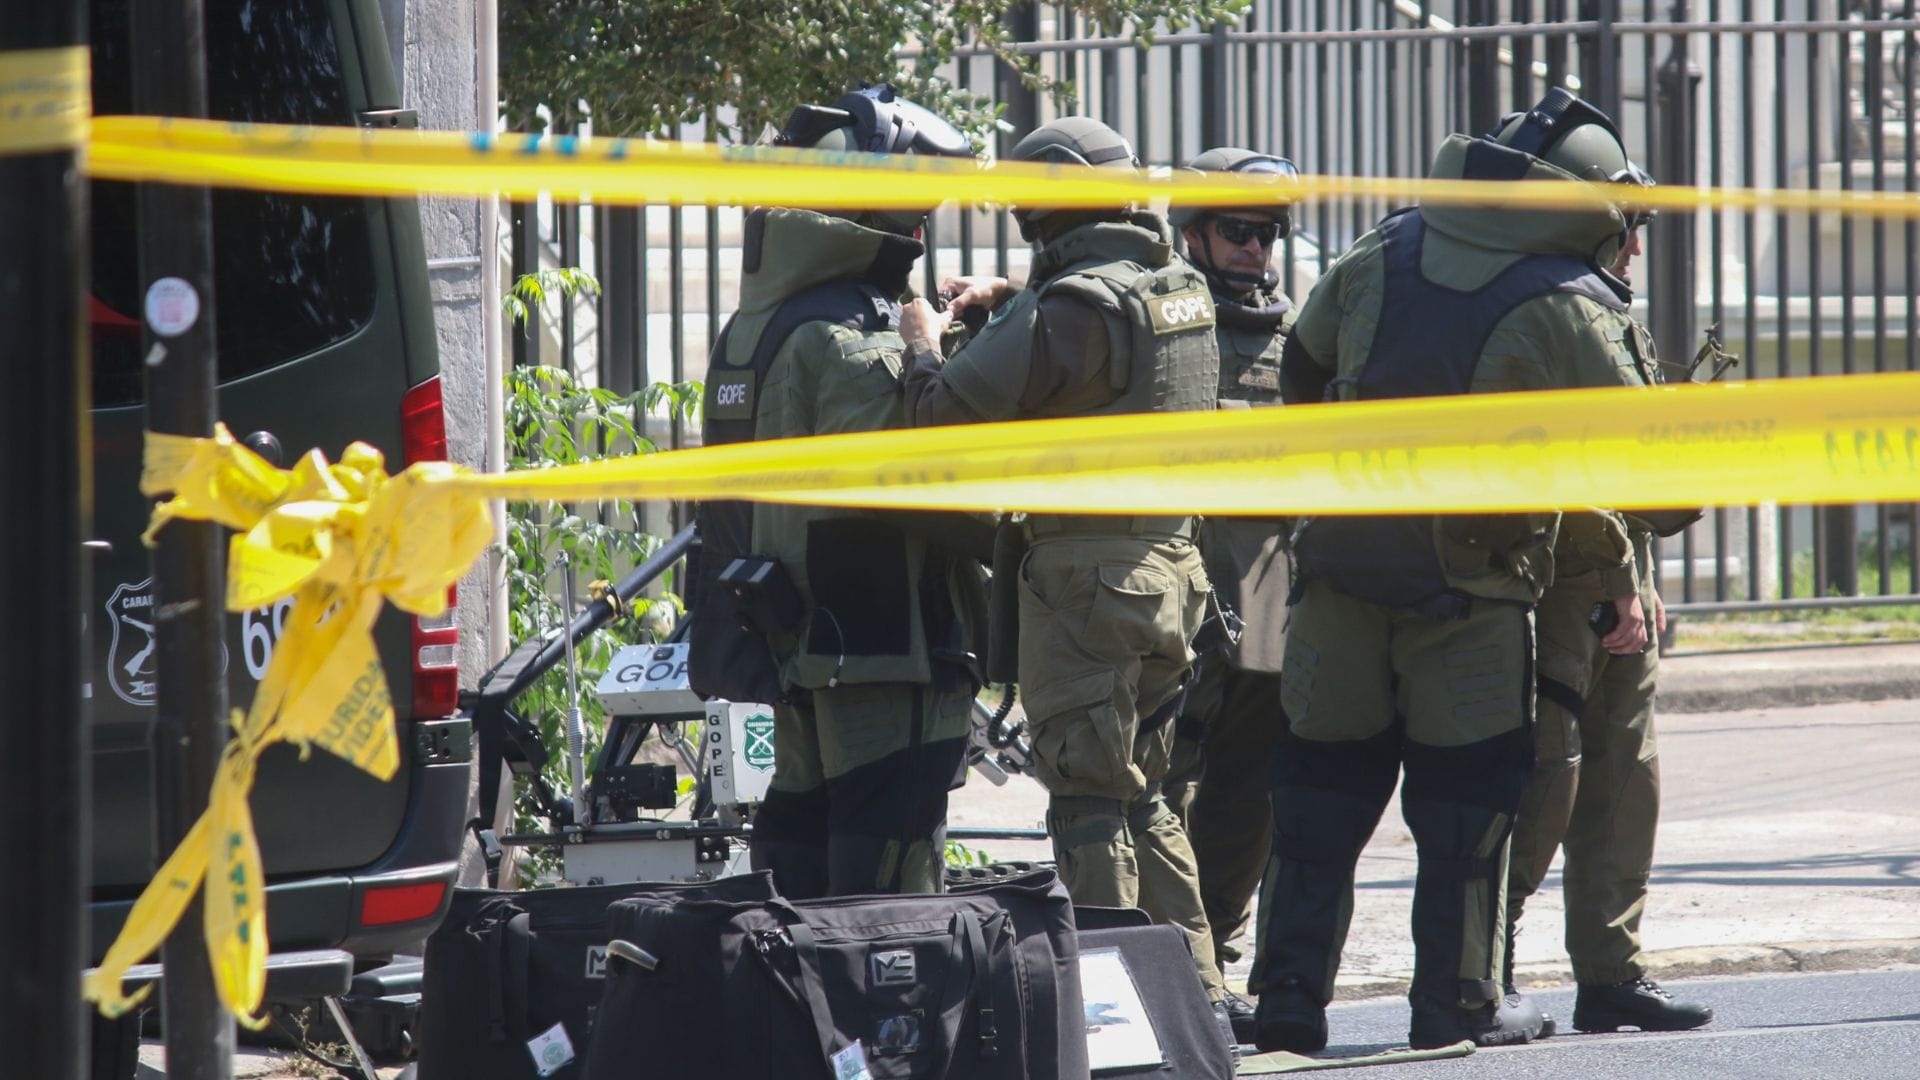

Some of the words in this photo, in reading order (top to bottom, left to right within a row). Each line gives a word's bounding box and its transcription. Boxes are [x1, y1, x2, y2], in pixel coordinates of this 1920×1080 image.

[1161, 295, 1211, 324] GOPE
[717, 383, 746, 405] GOPE
[708, 715, 724, 777] GOPE
